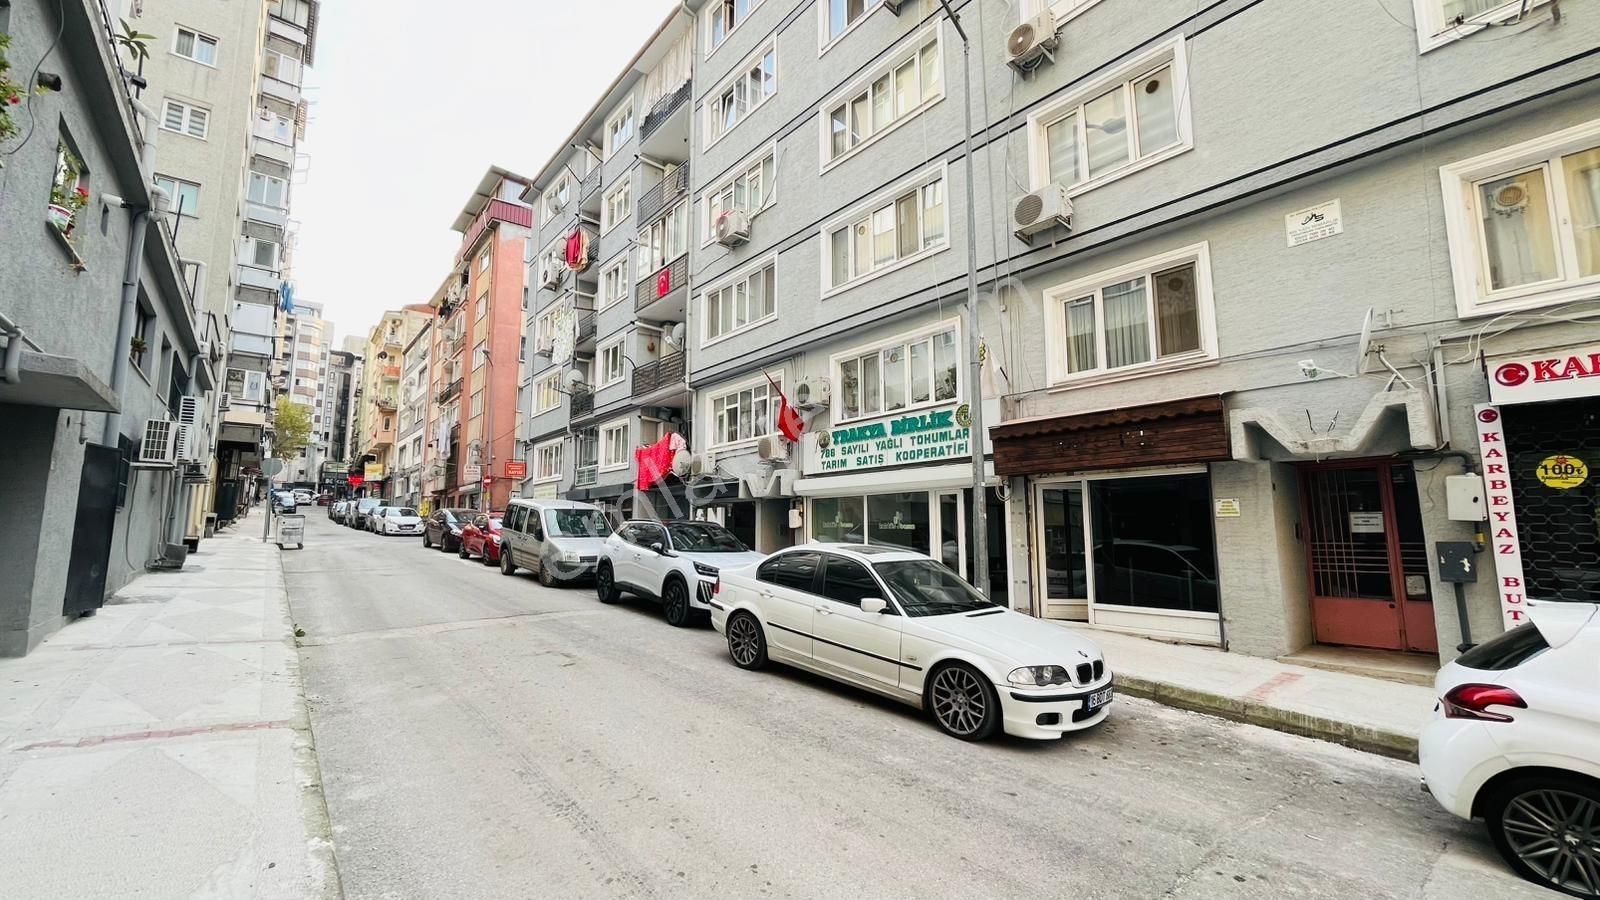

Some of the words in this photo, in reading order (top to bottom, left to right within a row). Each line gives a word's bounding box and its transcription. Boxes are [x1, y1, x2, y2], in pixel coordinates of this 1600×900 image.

[832, 423, 887, 445] TRAKYA
[891, 411, 954, 436] BİRLİK
[841, 443, 869, 456] SAYILI
[875, 438, 903, 451] YAĞLI
[910, 427, 970, 446] TOHUMLAR
[821, 459, 847, 471] TARIM
[856, 453, 884, 466] SATIŞ
[896, 440, 968, 462] KOOPERATİFİ
[1482, 432, 1515, 555] KARBEYAZ
[1503, 576, 1526, 627] BUT
